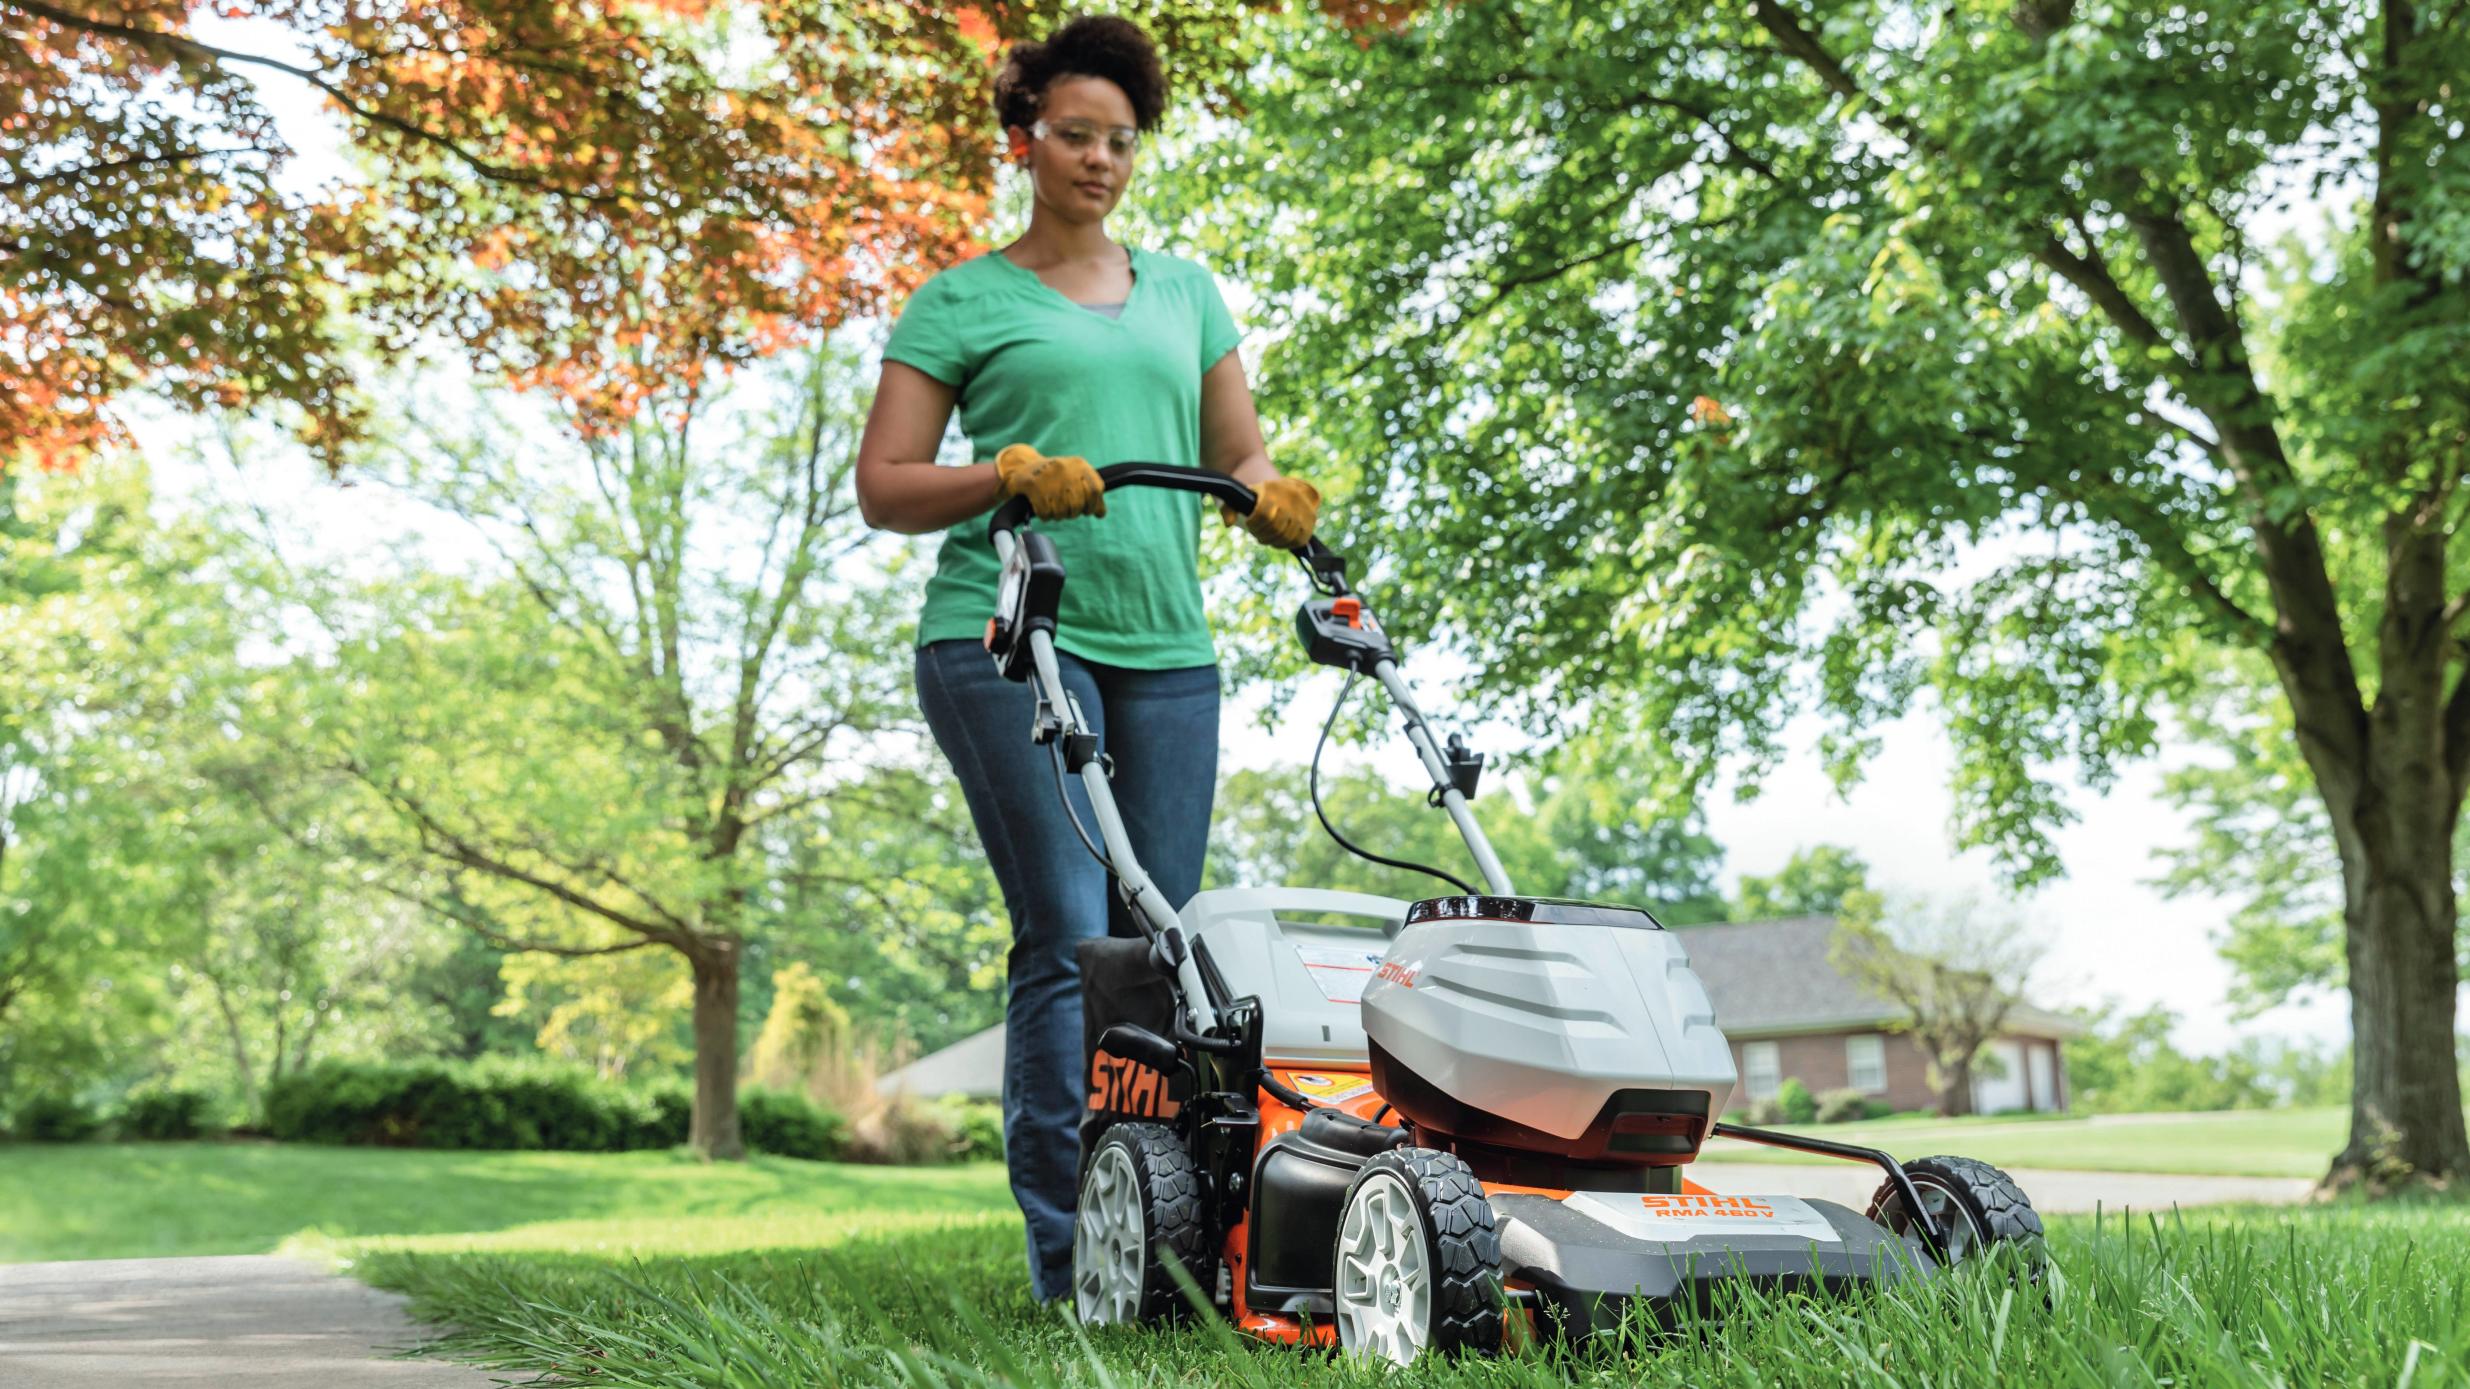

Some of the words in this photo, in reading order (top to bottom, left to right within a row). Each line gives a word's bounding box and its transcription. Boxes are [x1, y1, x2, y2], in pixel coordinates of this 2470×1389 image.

[1376, 962, 1414, 989] STIHL
[1088, 1049, 1180, 1118] STIHL
[1641, 1196, 1771, 1209] STIHL
[1655, 1209, 1709, 1217] RMA
